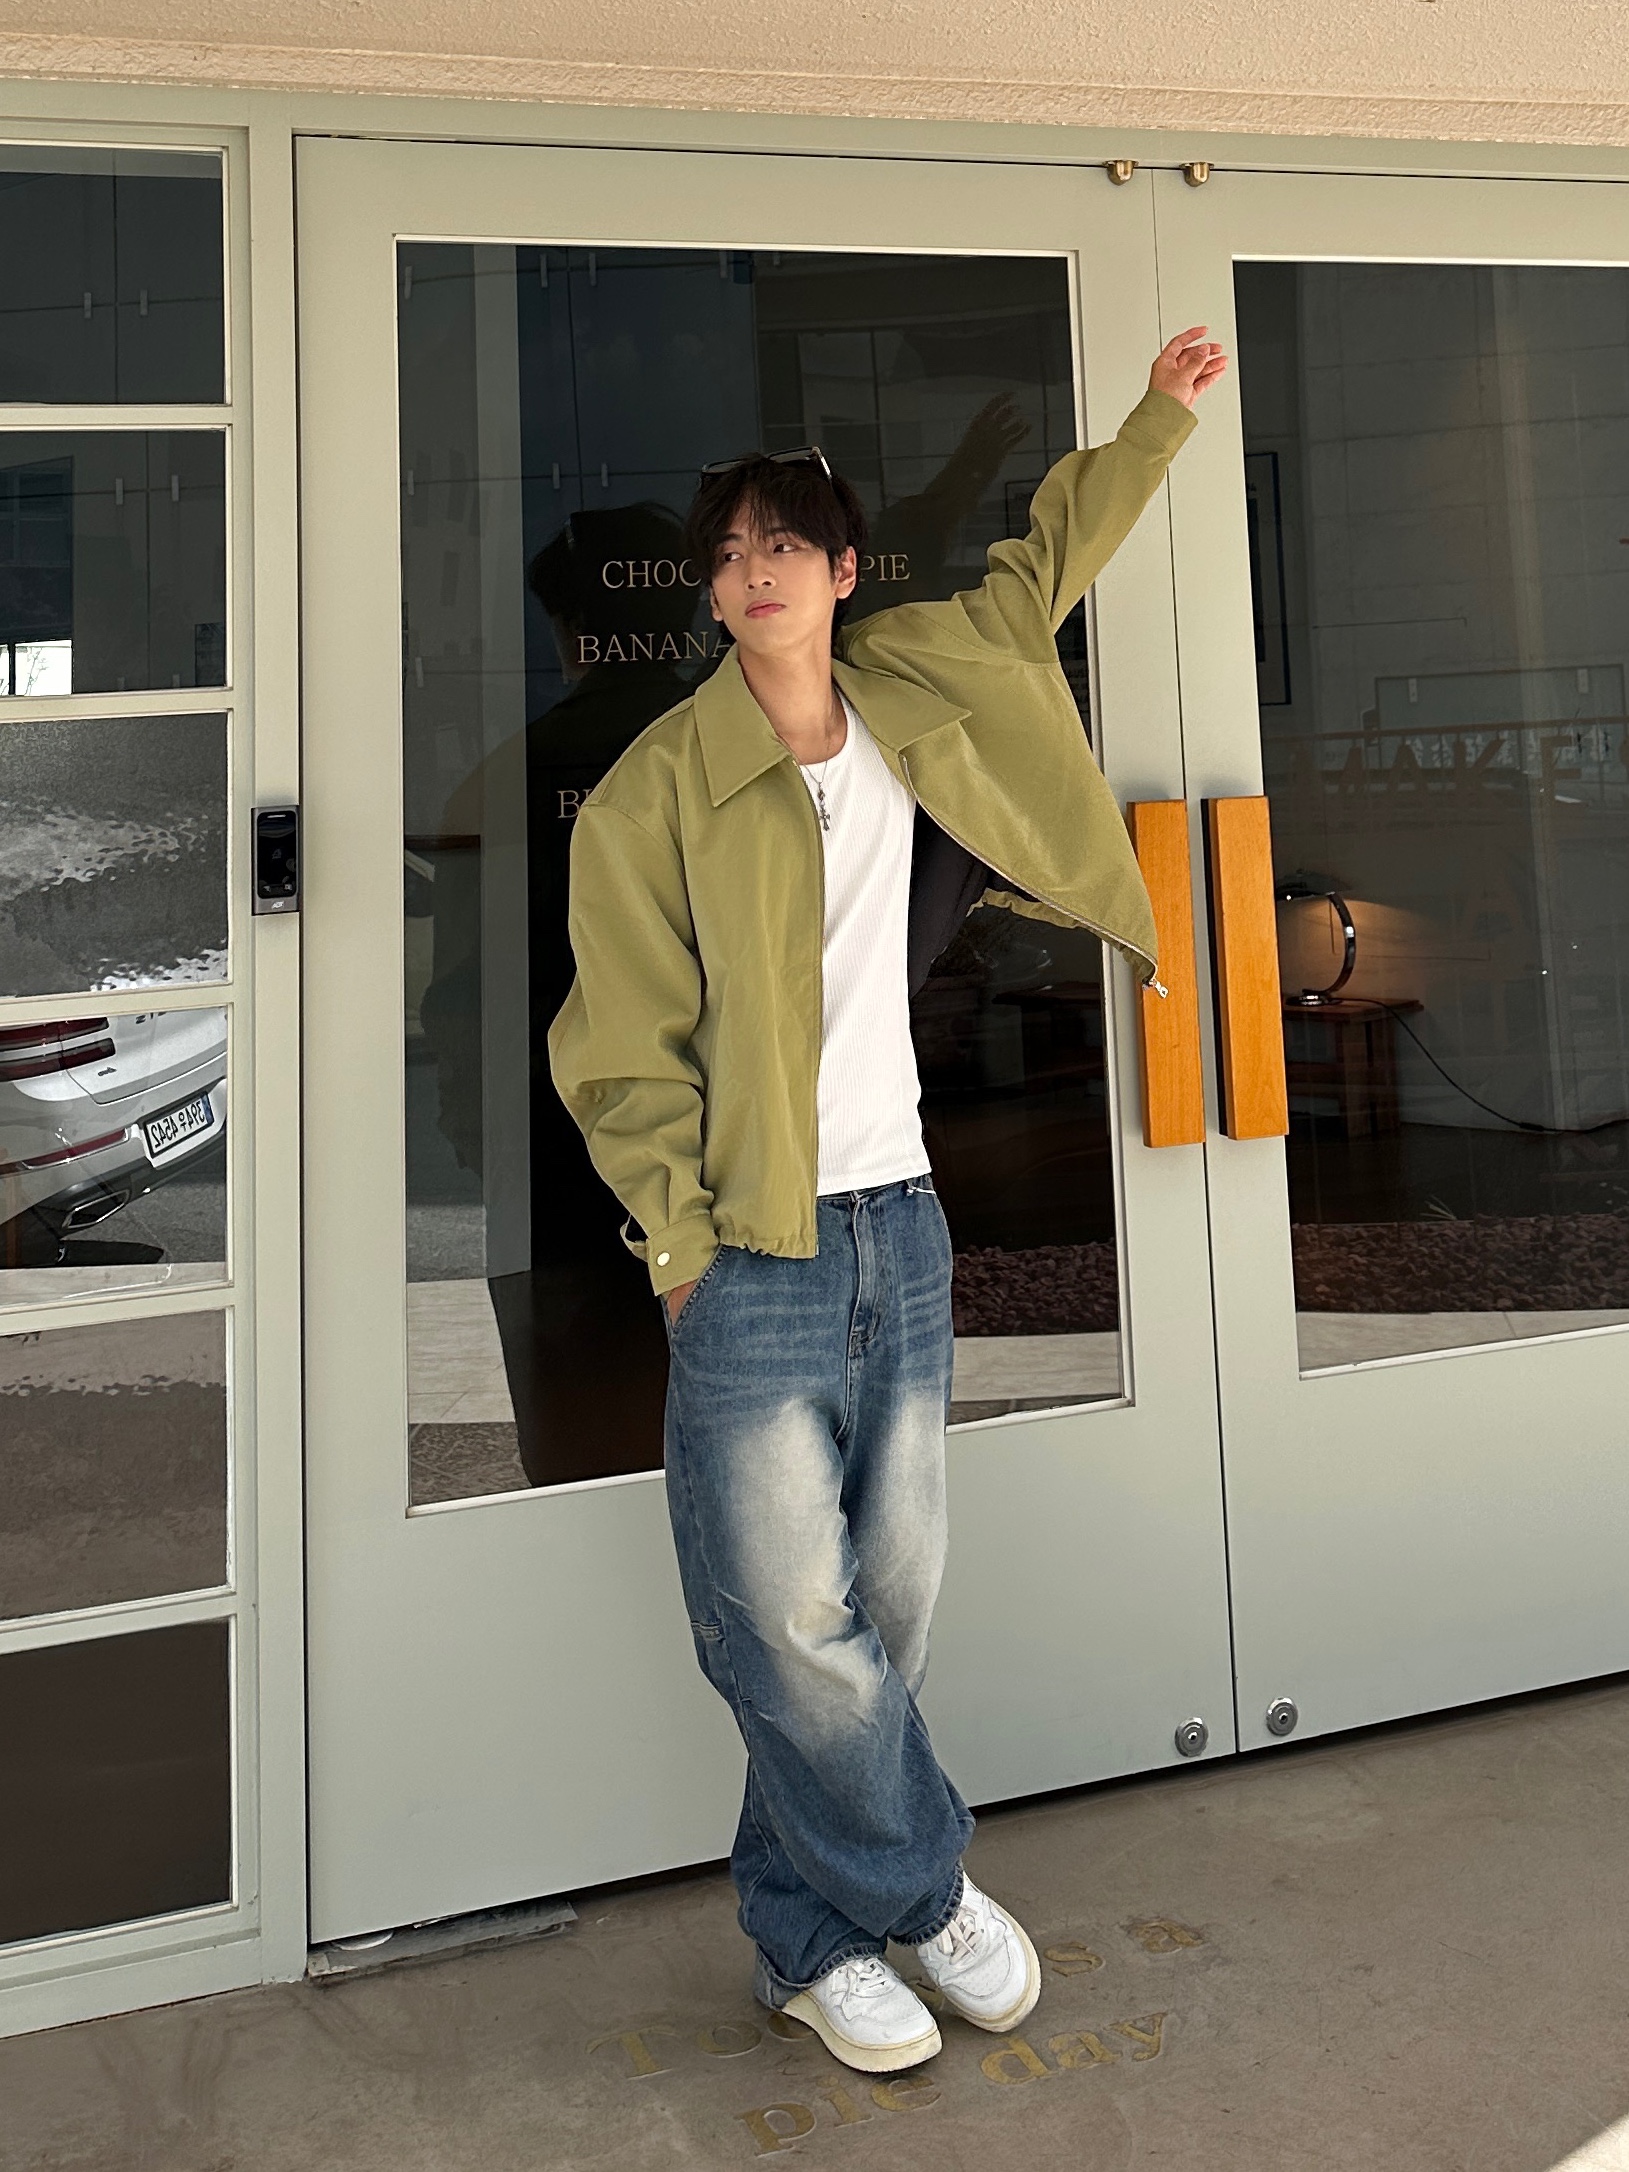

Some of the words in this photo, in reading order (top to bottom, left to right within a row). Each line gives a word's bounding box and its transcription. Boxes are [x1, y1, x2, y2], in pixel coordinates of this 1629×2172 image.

[859, 554, 910, 582] PIE
[734, 2075, 943, 2158] pie
[981, 2012, 1168, 2086] day
